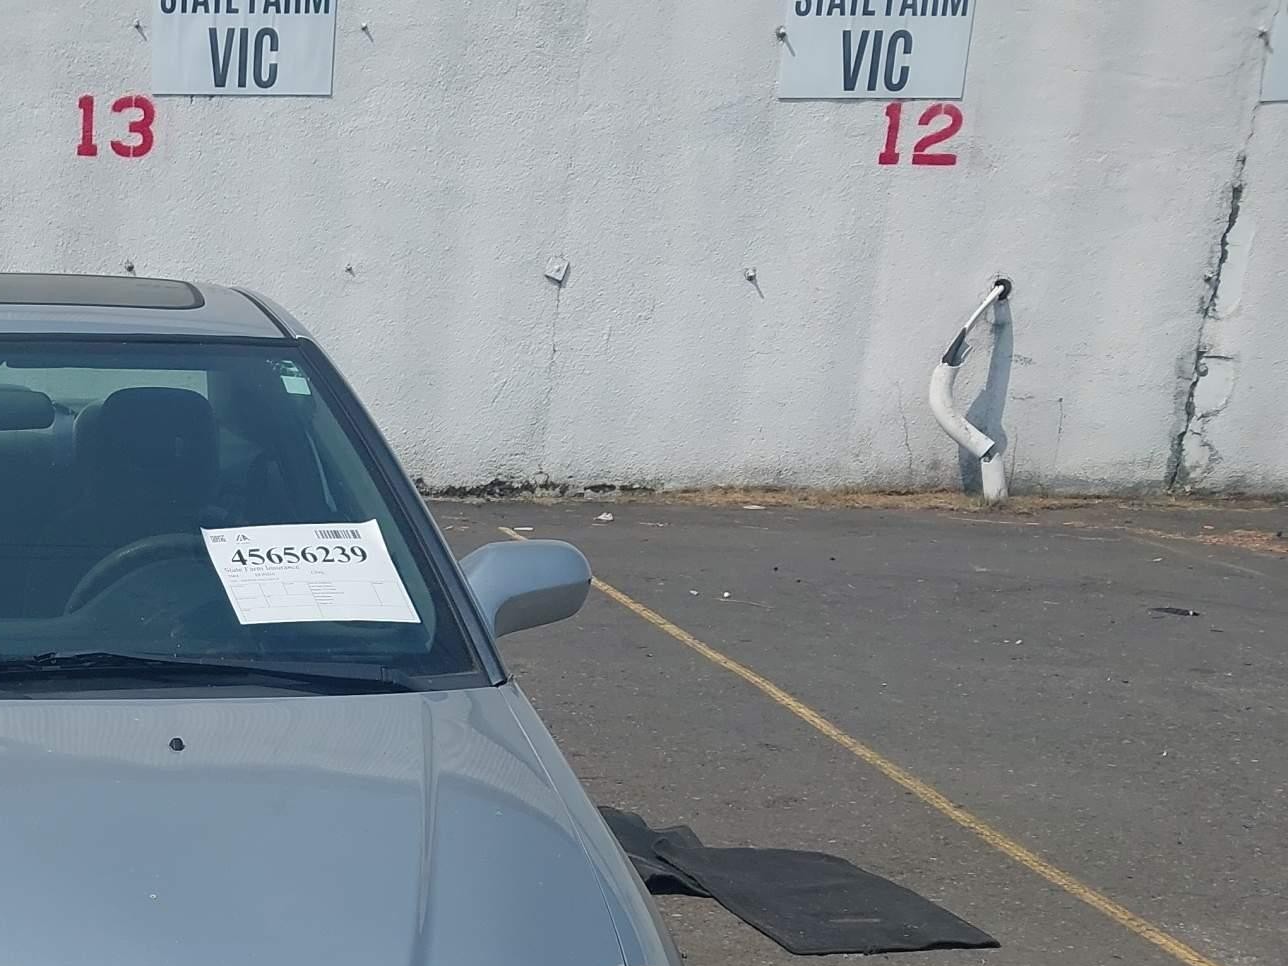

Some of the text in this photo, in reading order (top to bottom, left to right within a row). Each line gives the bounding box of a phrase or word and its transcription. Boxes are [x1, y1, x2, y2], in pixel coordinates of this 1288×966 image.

[208, 27, 279, 89] VIC
[842, 29, 913, 92] VIC
[77, 95, 155, 158] 13
[878, 102, 963, 165] 12
[231, 545, 368, 565] 45656239
